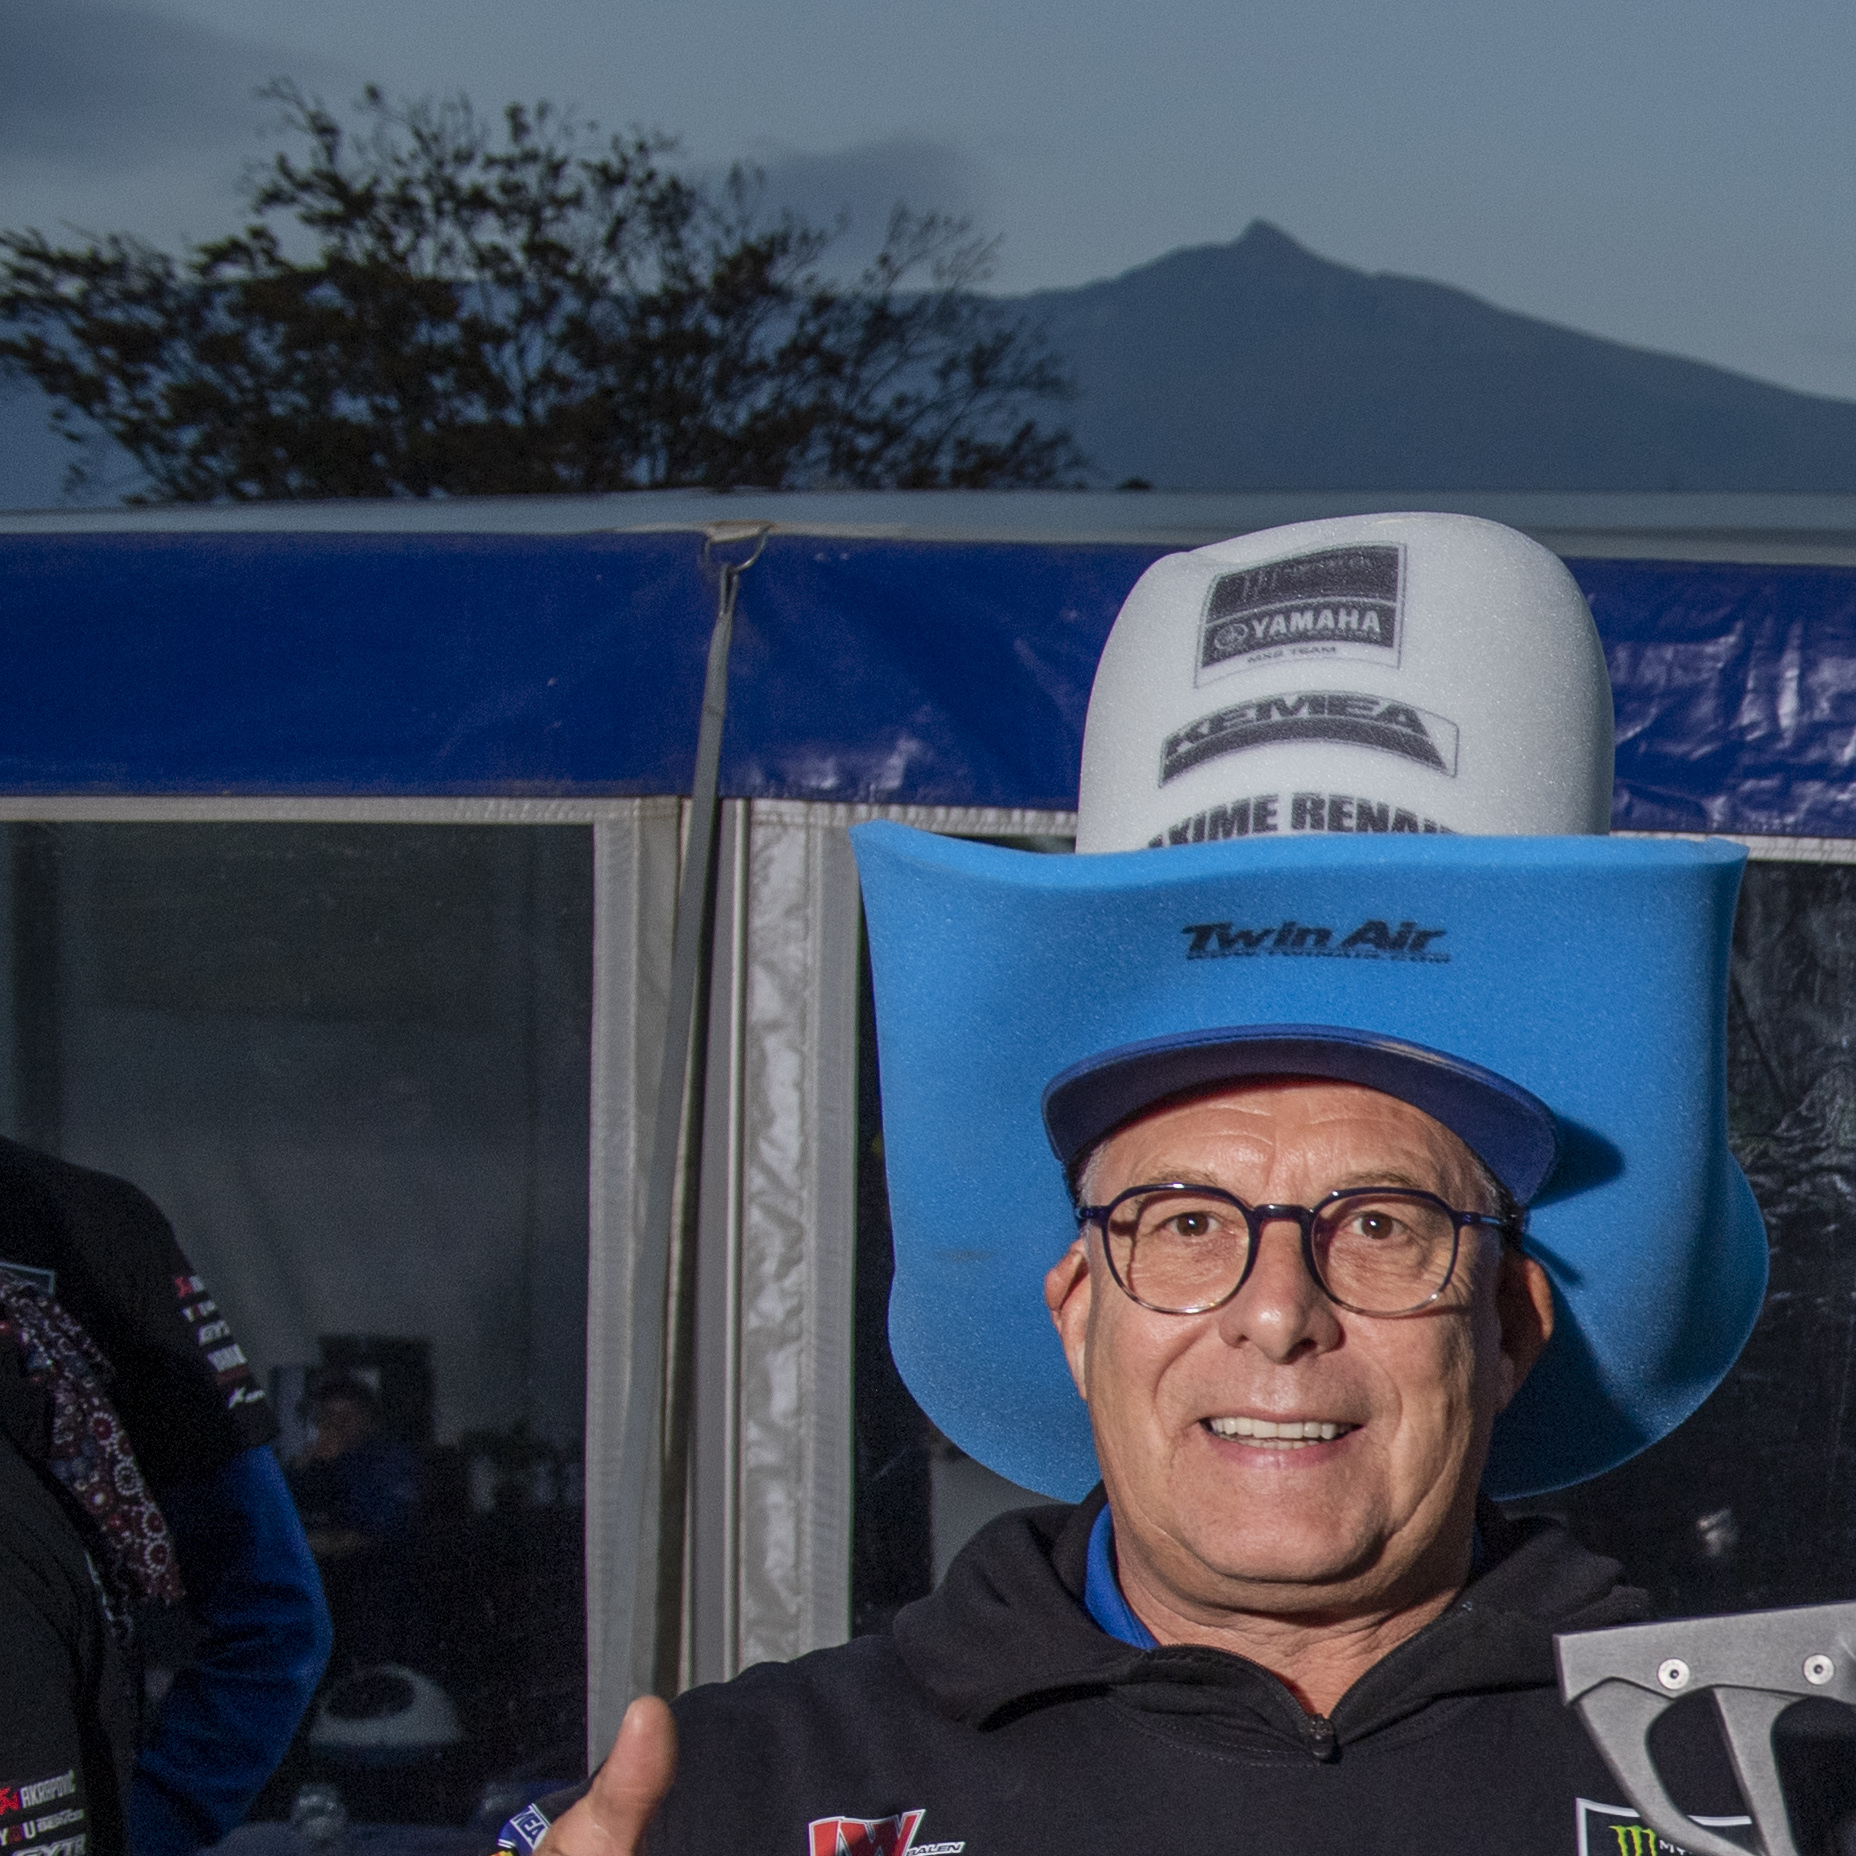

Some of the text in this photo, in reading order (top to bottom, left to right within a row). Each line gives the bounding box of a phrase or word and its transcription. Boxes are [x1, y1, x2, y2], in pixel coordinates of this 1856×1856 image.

[1253, 608, 1381, 638] YAMAHA
[1164, 693, 1431, 758] KEMEA
[1291, 792, 1460, 834] RENA
[1181, 920, 1447, 951] Twin Air
